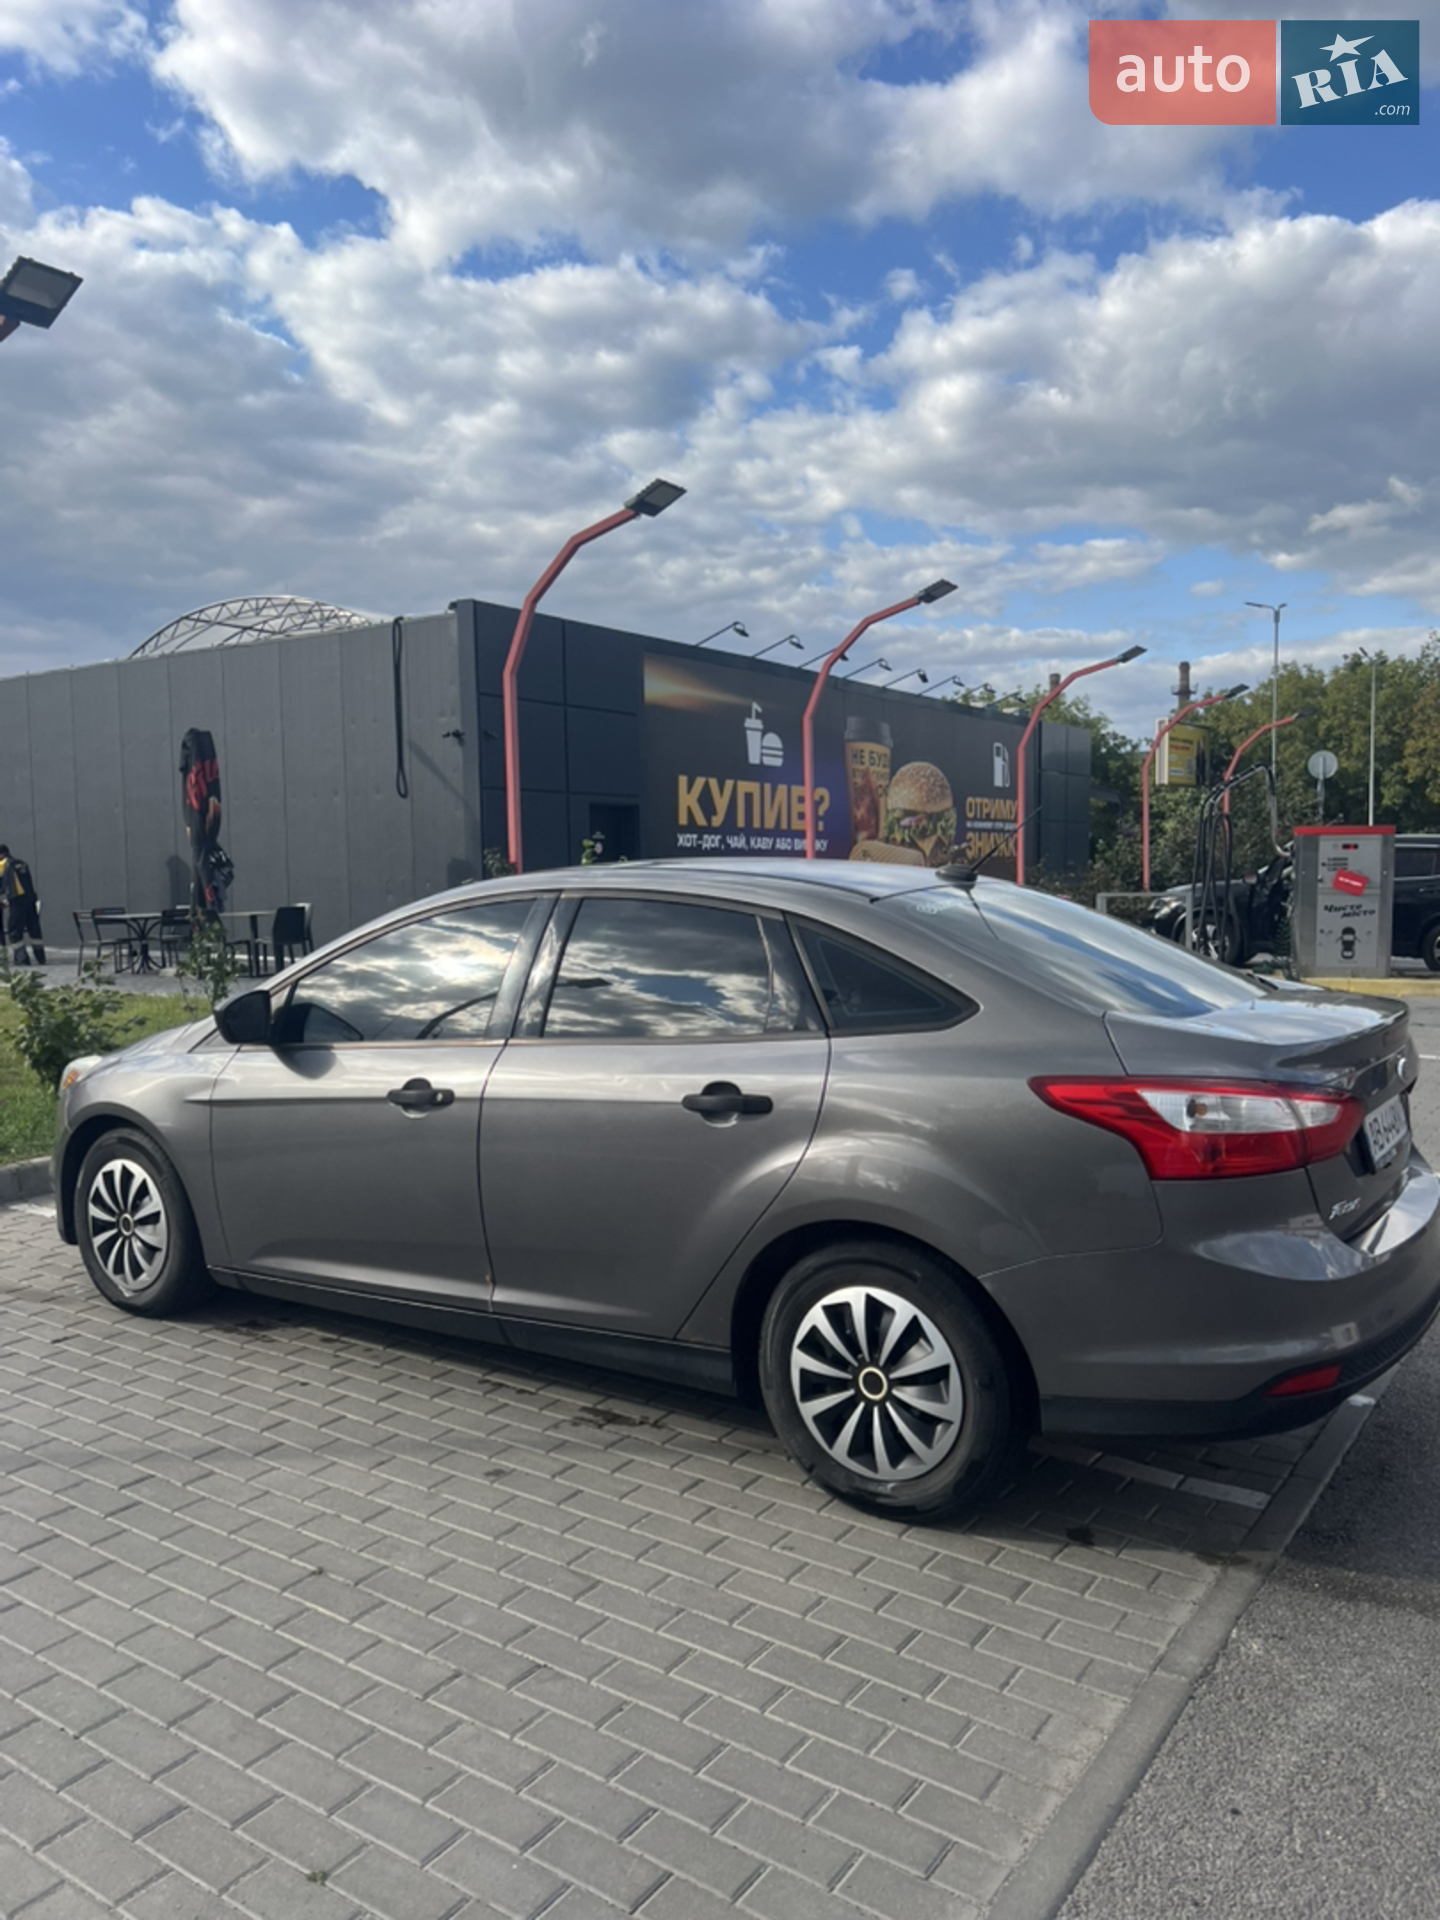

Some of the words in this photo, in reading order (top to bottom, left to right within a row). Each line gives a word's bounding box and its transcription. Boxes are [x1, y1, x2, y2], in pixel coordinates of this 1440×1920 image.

[966, 795, 1018, 821] ОТРИМУ
[749, 835, 774, 851] КАВУ
[775, 836, 792, 851] АБО
